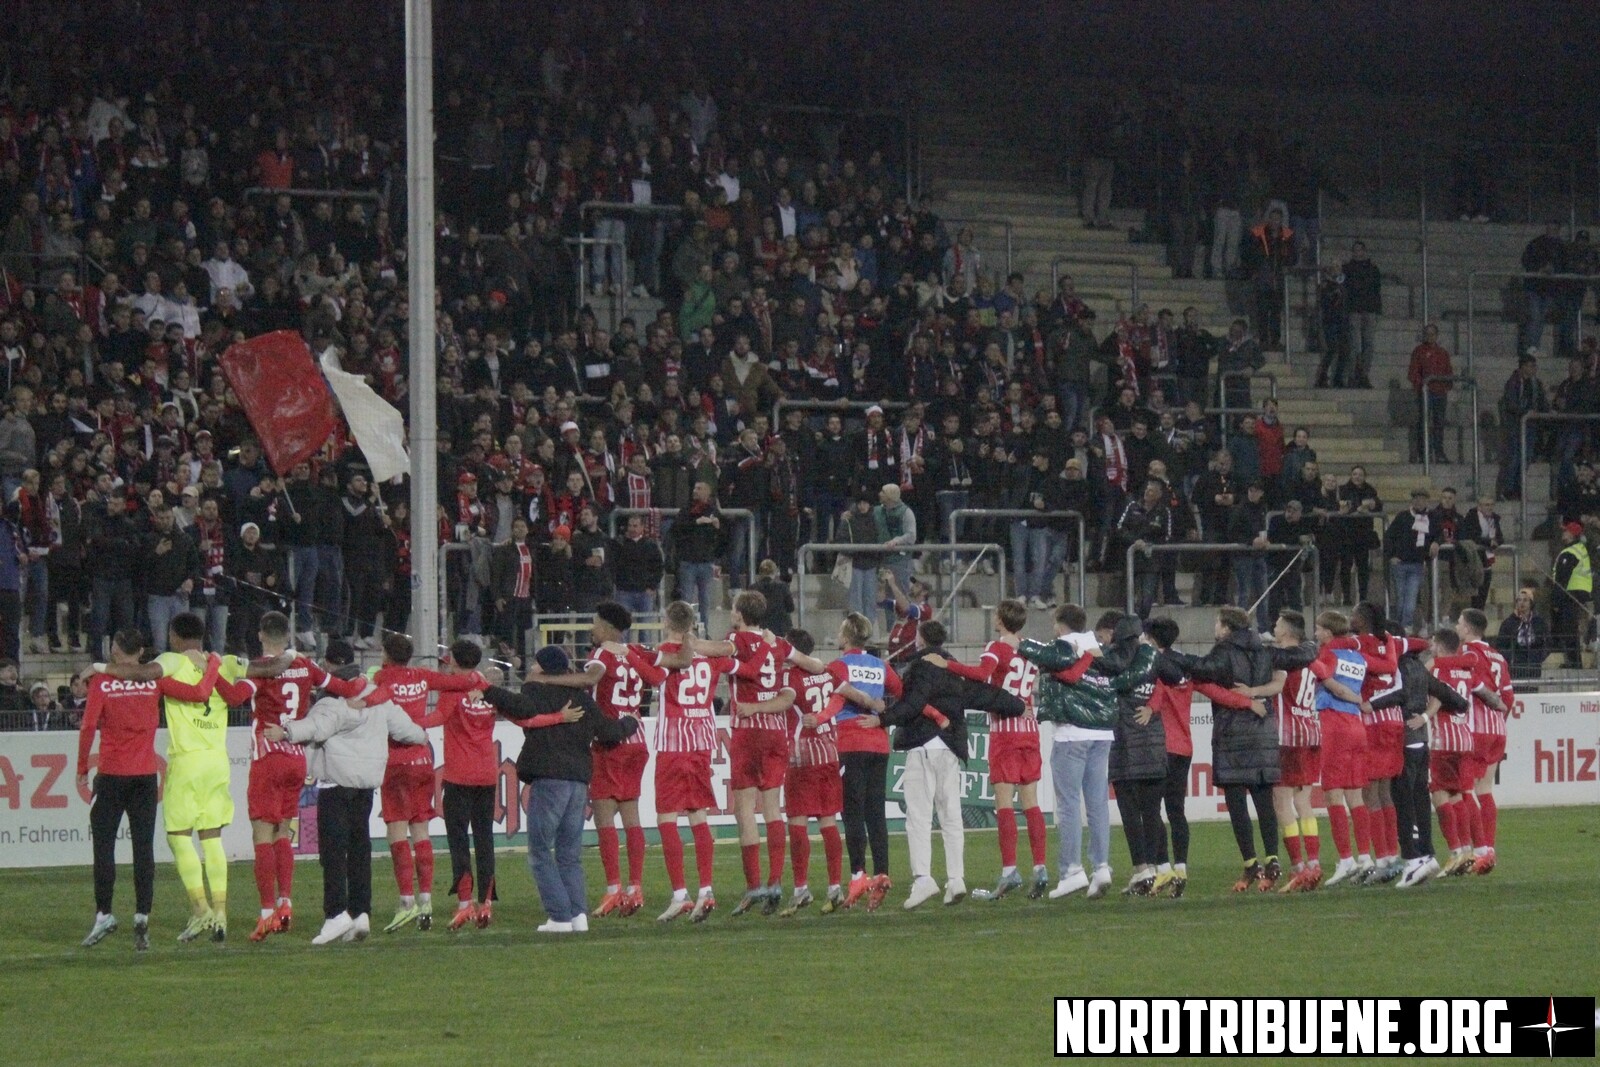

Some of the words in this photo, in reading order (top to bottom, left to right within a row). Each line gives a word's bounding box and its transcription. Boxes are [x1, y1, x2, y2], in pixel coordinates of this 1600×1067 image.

[611, 665, 643, 707] 23
[678, 662, 711, 705] 29
[760, 651, 776, 688] 9
[1002, 657, 1038, 697] 26
[281, 682, 299, 722] 3
[1190, 715, 1214, 725] enste
[1541, 703, 1565, 713] Türen
[20, 825, 83, 843] Fahren.
